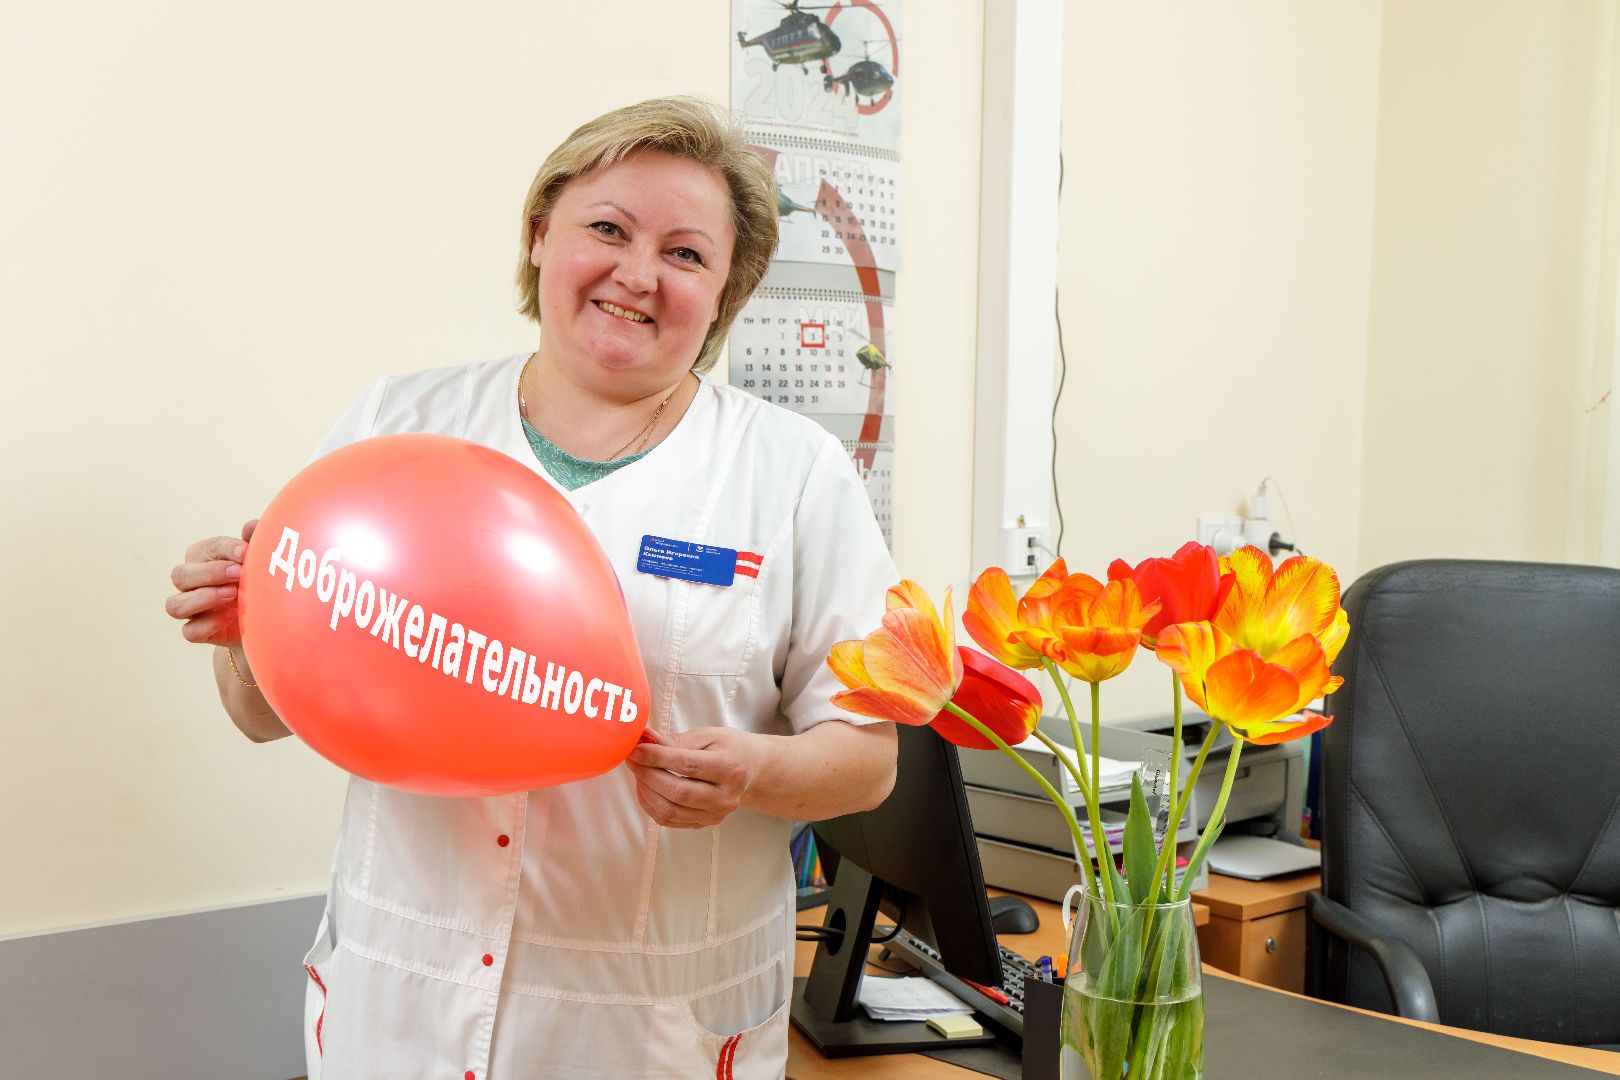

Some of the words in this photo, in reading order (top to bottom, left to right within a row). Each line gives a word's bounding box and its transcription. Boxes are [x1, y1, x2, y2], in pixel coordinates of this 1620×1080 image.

[821, 230, 830, 238] 22
[825, 349, 830, 357] 11
[779, 364, 787, 372] 15
[795, 364, 803, 372] 16
[838, 365, 844, 373] 19
[743, 380, 755, 388] 20
[778, 380, 788, 388] 22
[794, 380, 804, 388] 23
[809, 380, 819, 388] 24
[794, 396, 805, 404] 30
[811, 396, 819, 404] 31
